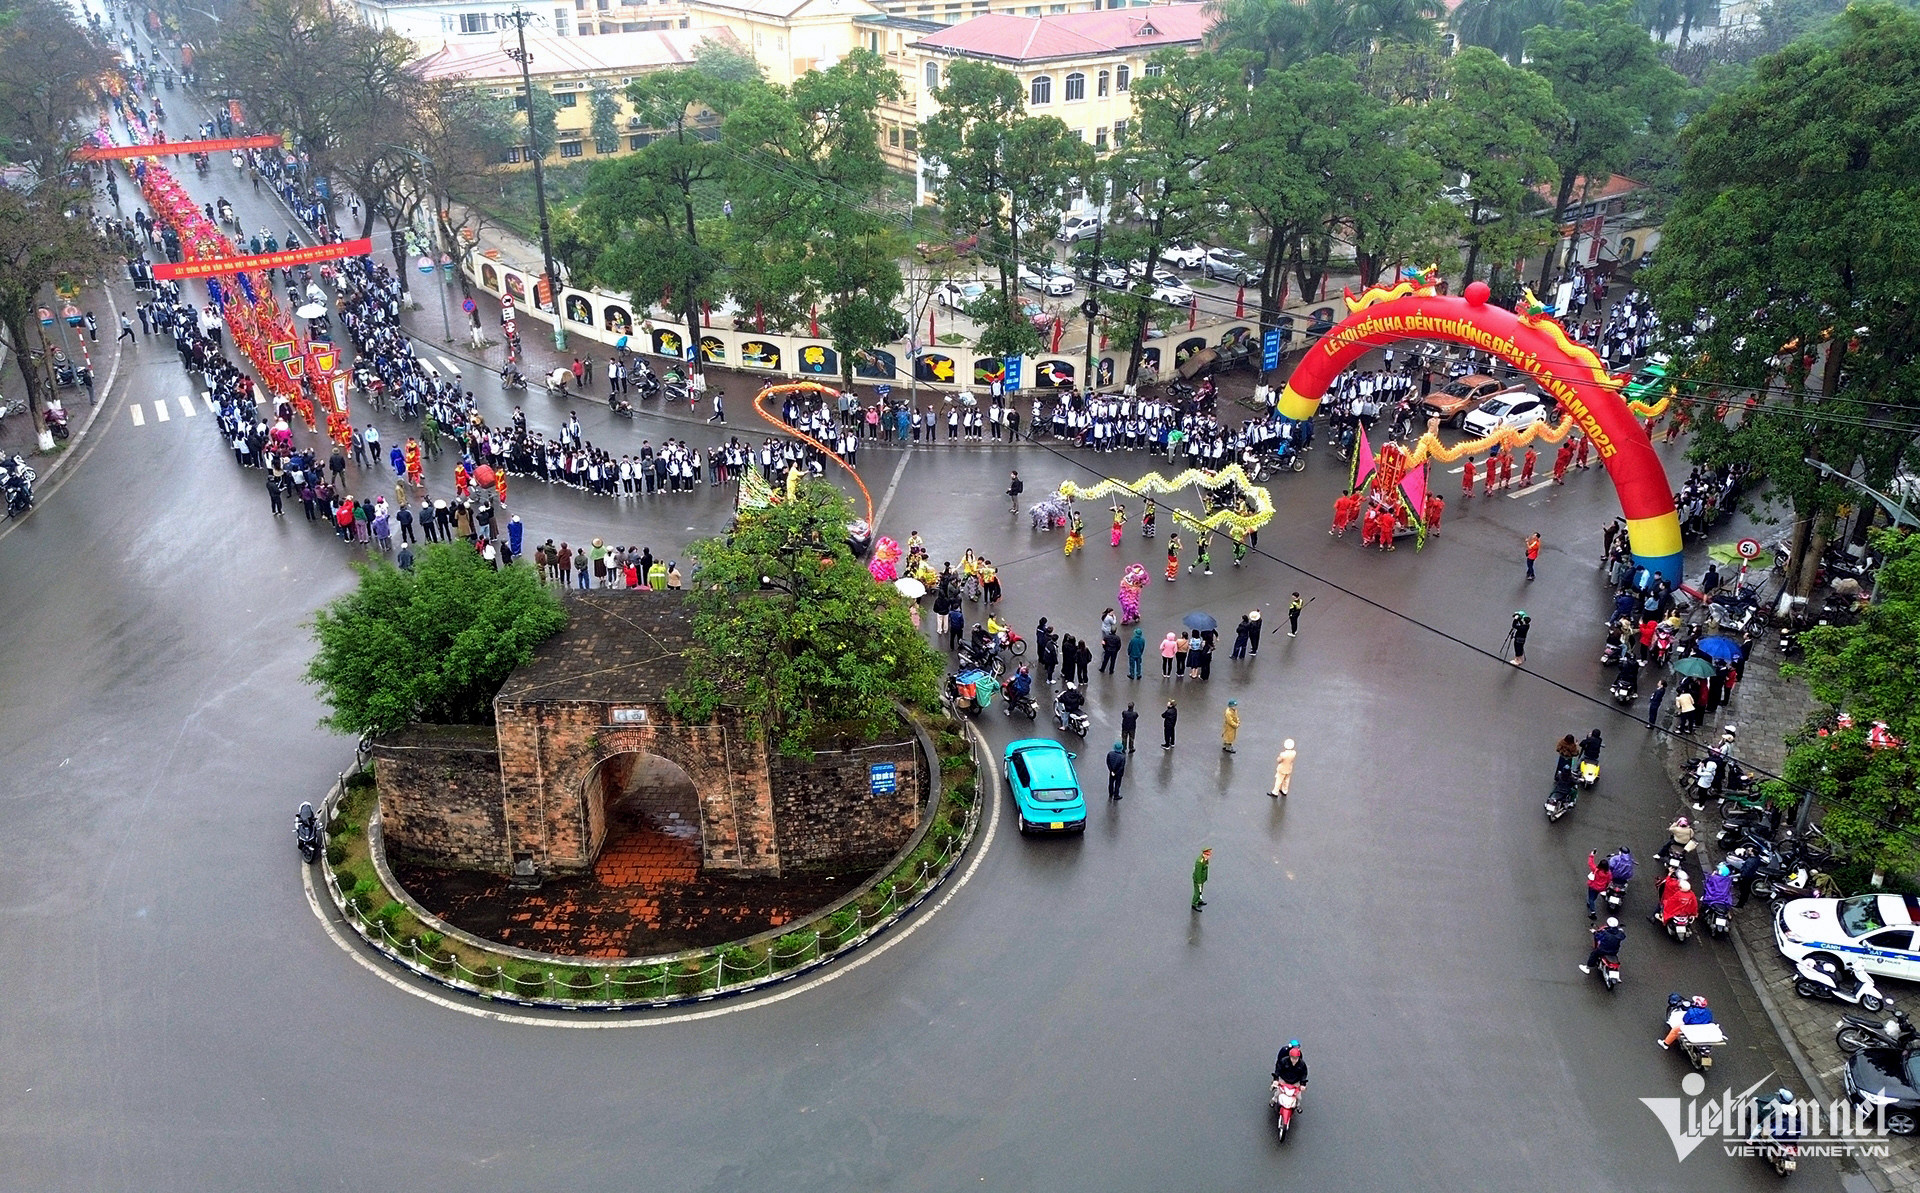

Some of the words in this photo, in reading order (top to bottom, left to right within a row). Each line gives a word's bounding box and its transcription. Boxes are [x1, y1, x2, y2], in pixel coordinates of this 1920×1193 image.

[1405, 309, 1434, 332] ĐỀN
[1491, 335, 1525, 366] ĐỀN
[1549, 380, 1589, 420] NĂM
[1581, 415, 1617, 458] 2025
[1742, 543, 1753, 555] 5t
